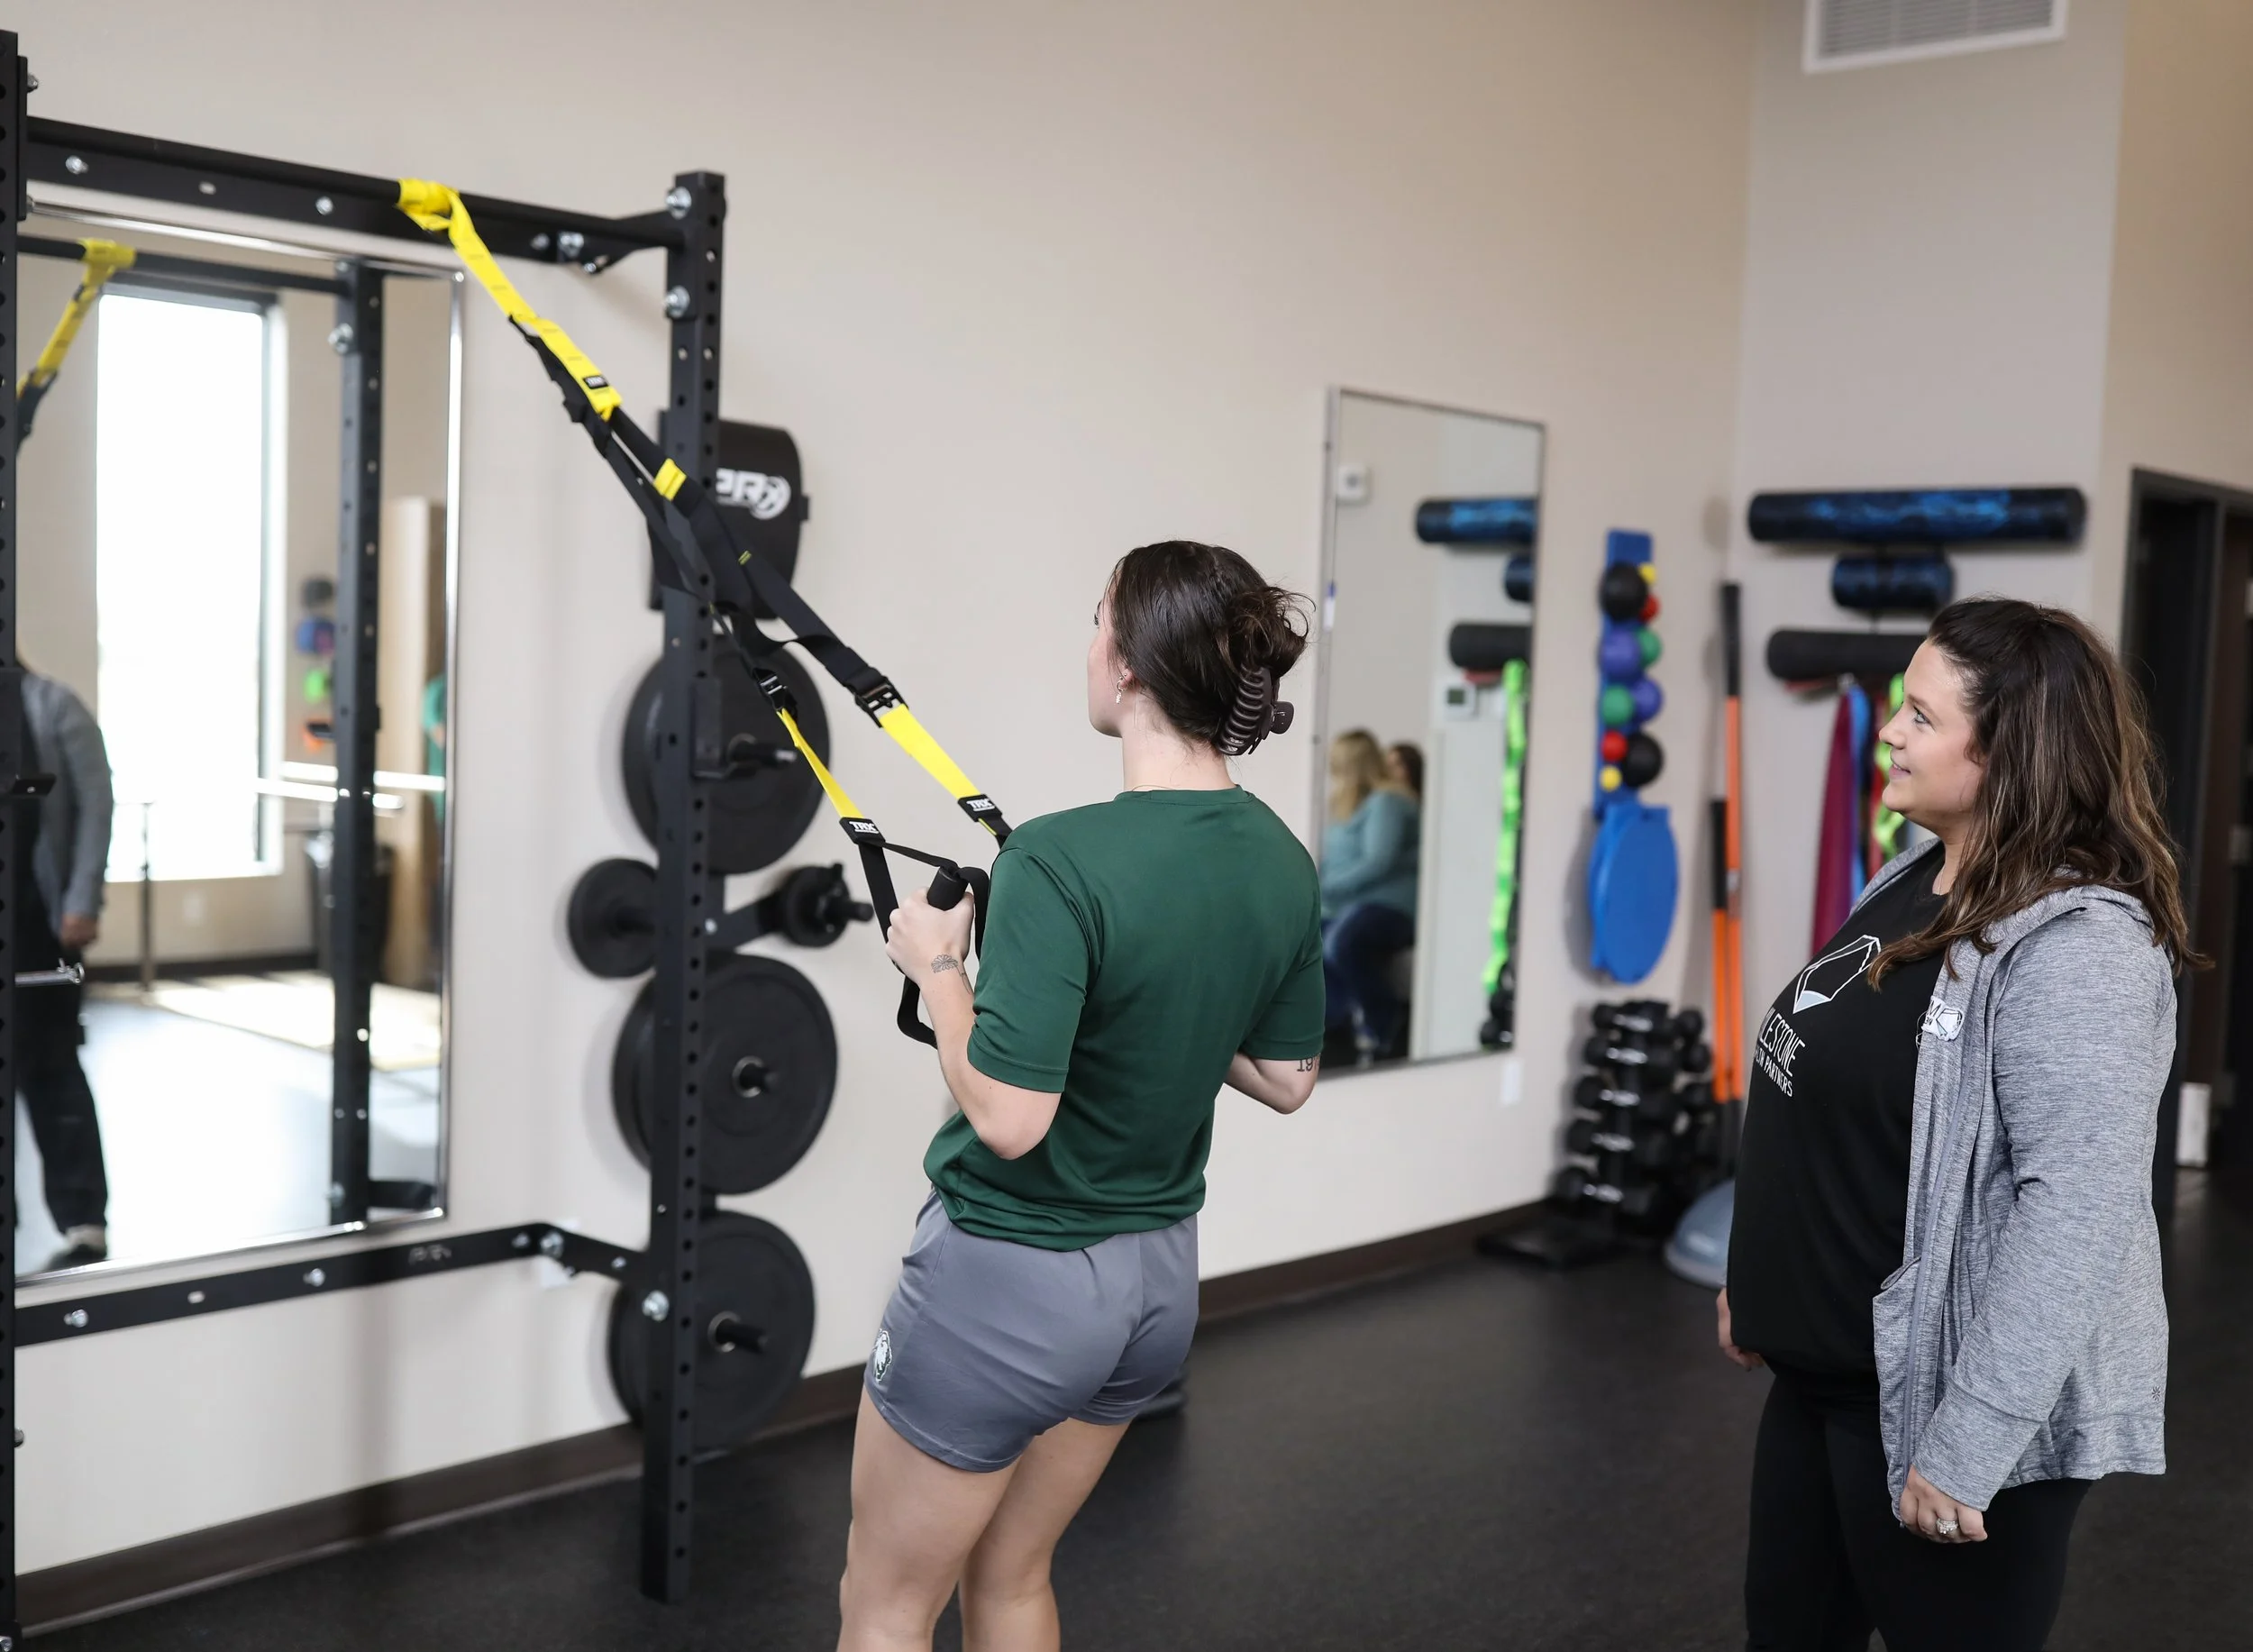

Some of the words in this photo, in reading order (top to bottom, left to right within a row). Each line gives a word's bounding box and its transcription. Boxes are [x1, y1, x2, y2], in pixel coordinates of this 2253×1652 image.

[966, 799, 993, 809] TRX
[849, 821, 876, 832] TRX
[1758, 1007, 1806, 1077] LESTONE
